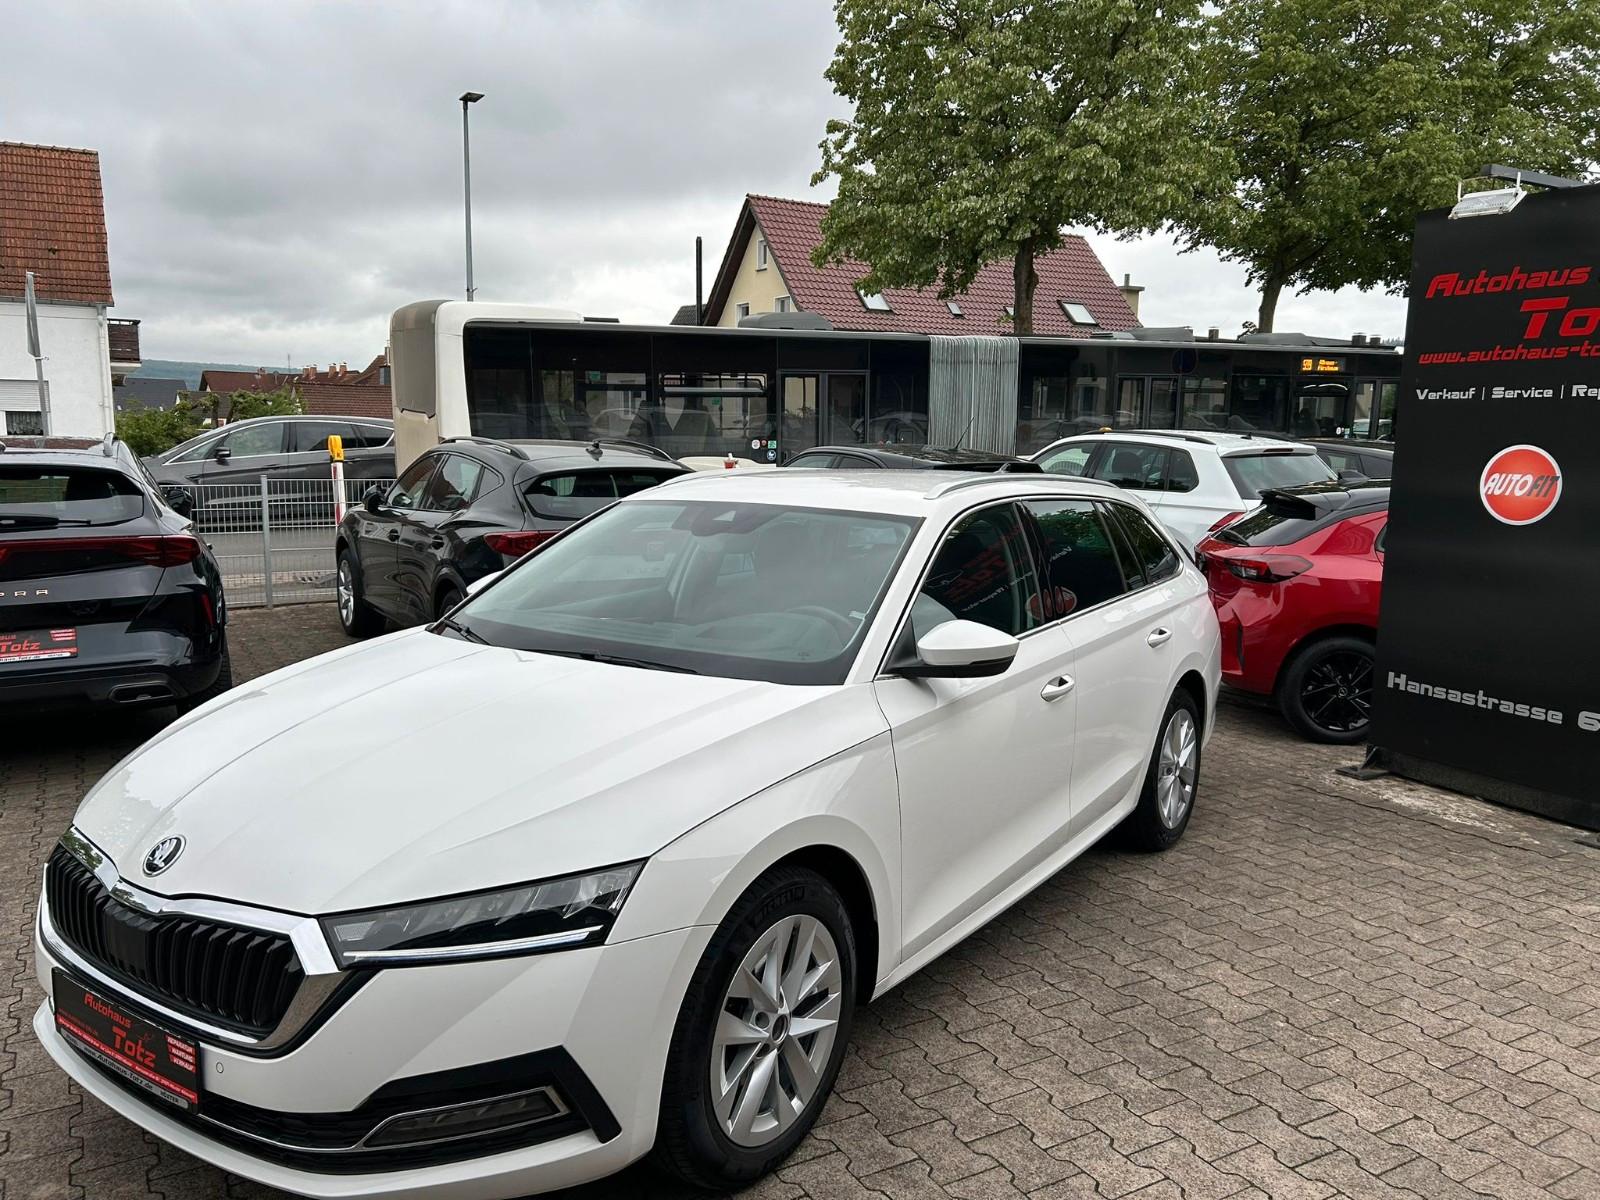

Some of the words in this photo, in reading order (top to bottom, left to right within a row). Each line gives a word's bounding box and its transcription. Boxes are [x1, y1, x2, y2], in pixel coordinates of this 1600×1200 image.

[1425, 266, 1592, 299] Autohaus
[1416, 387, 1476, 400] Verkauf
[1492, 386, 1553, 399] Service
[1484, 473, 1560, 497] AUTOFIT
[1387, 671, 1563, 725] Hansastrasse
[84, 992, 132, 1028] Autohaus
[112, 1025, 157, 1068] Totz
